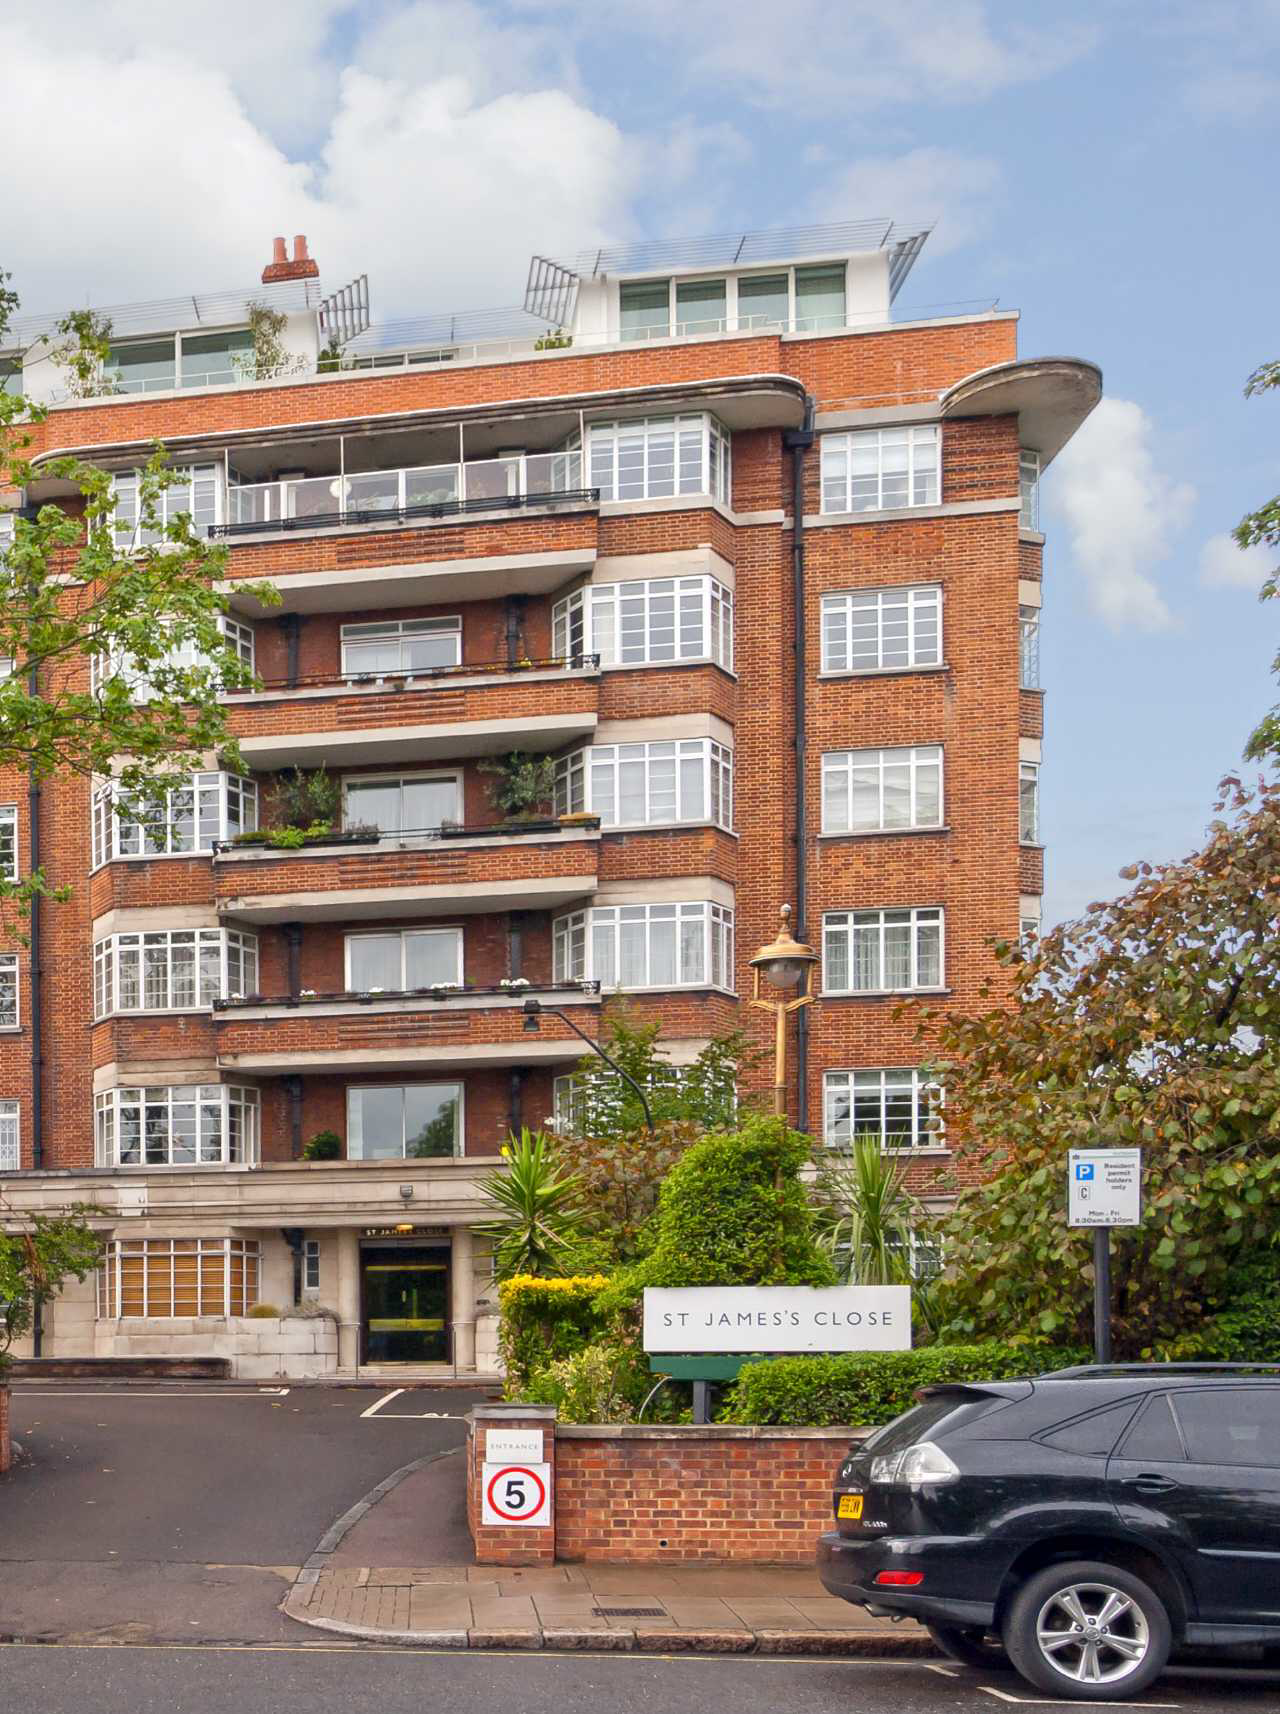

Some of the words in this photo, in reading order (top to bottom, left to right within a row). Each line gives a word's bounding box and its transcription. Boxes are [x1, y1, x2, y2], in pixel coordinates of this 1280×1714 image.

[1079, 1166, 1090, 1179] P
[663, 1312, 689, 1327] ST
[705, 1310, 800, 1327] JAMES'S
[814, 1311, 893, 1326] CLOSE
[504, 1480, 526, 1509] 5
